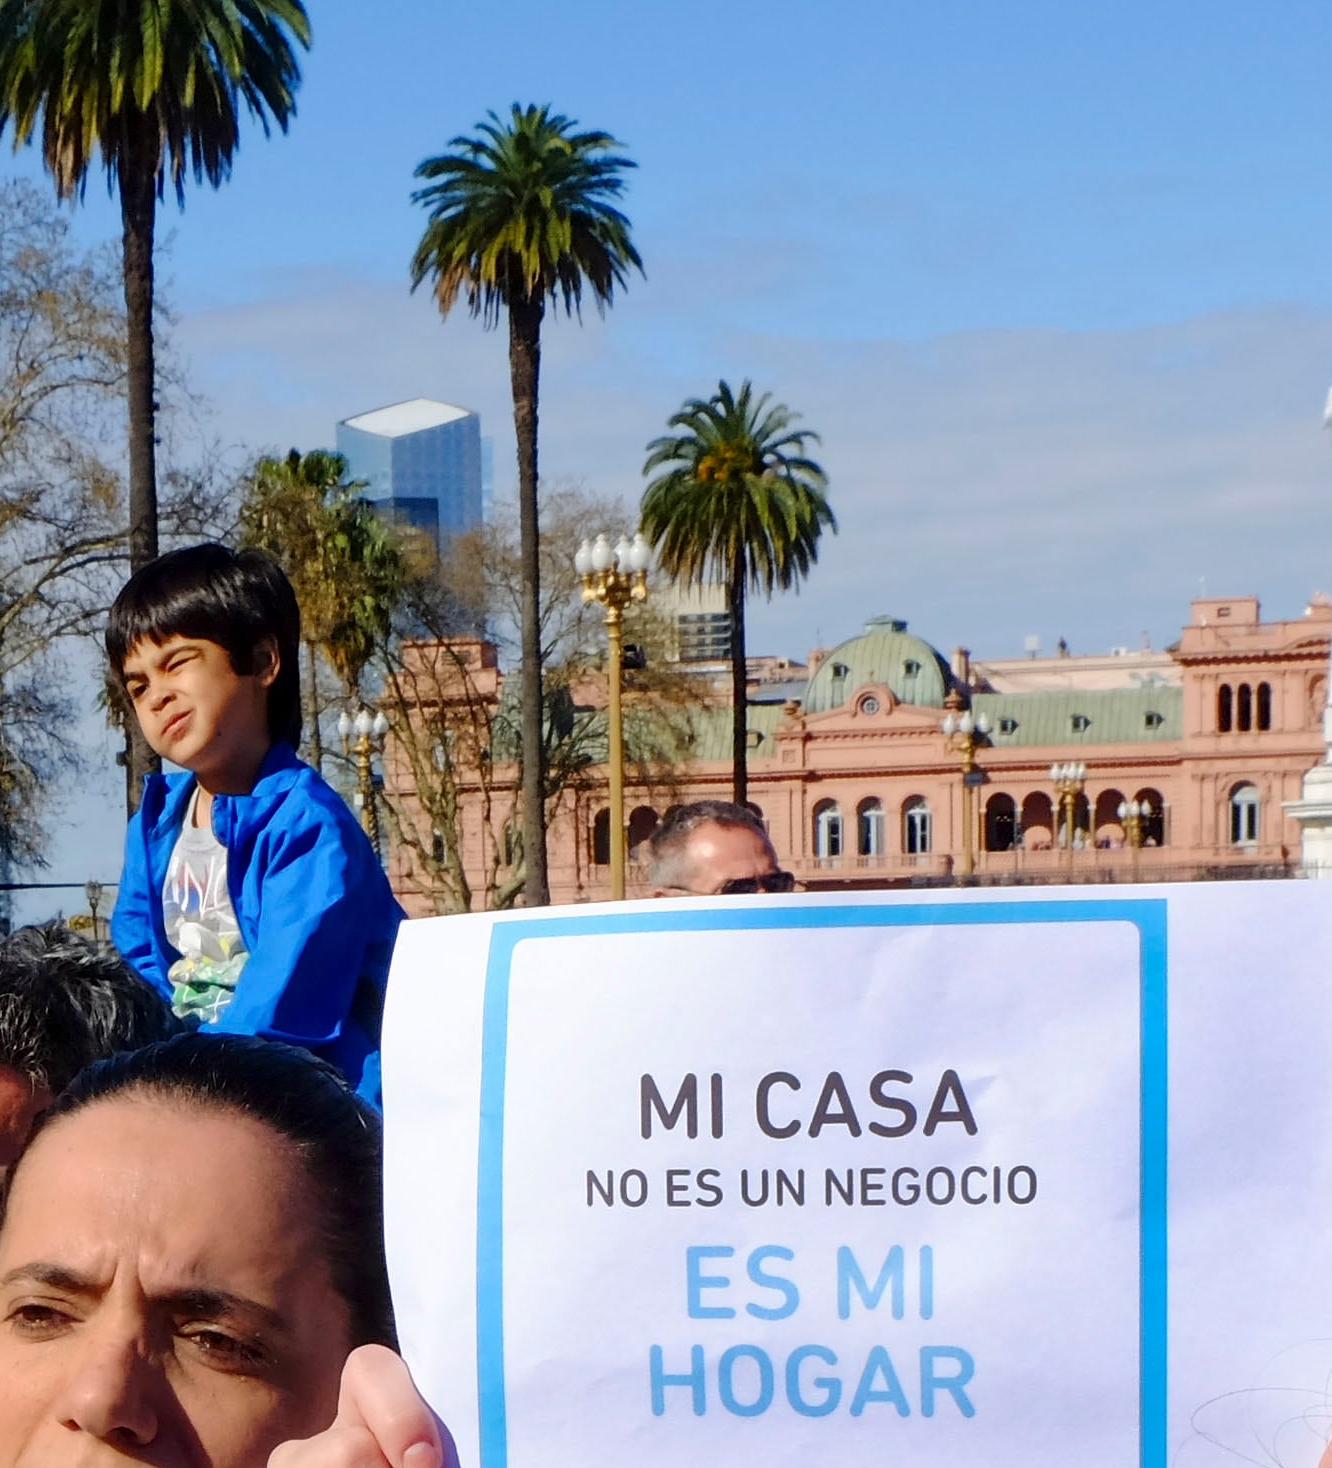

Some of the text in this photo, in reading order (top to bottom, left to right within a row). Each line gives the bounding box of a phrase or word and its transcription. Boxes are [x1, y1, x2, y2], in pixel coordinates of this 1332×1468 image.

[640, 1068, 979, 1140] MI CASA
[586, 1164, 1038, 1208] NO ES UN NEGOCIO
[685, 1244, 934, 1322] ES MI
[649, 1344, 976, 1419] HOGAR
